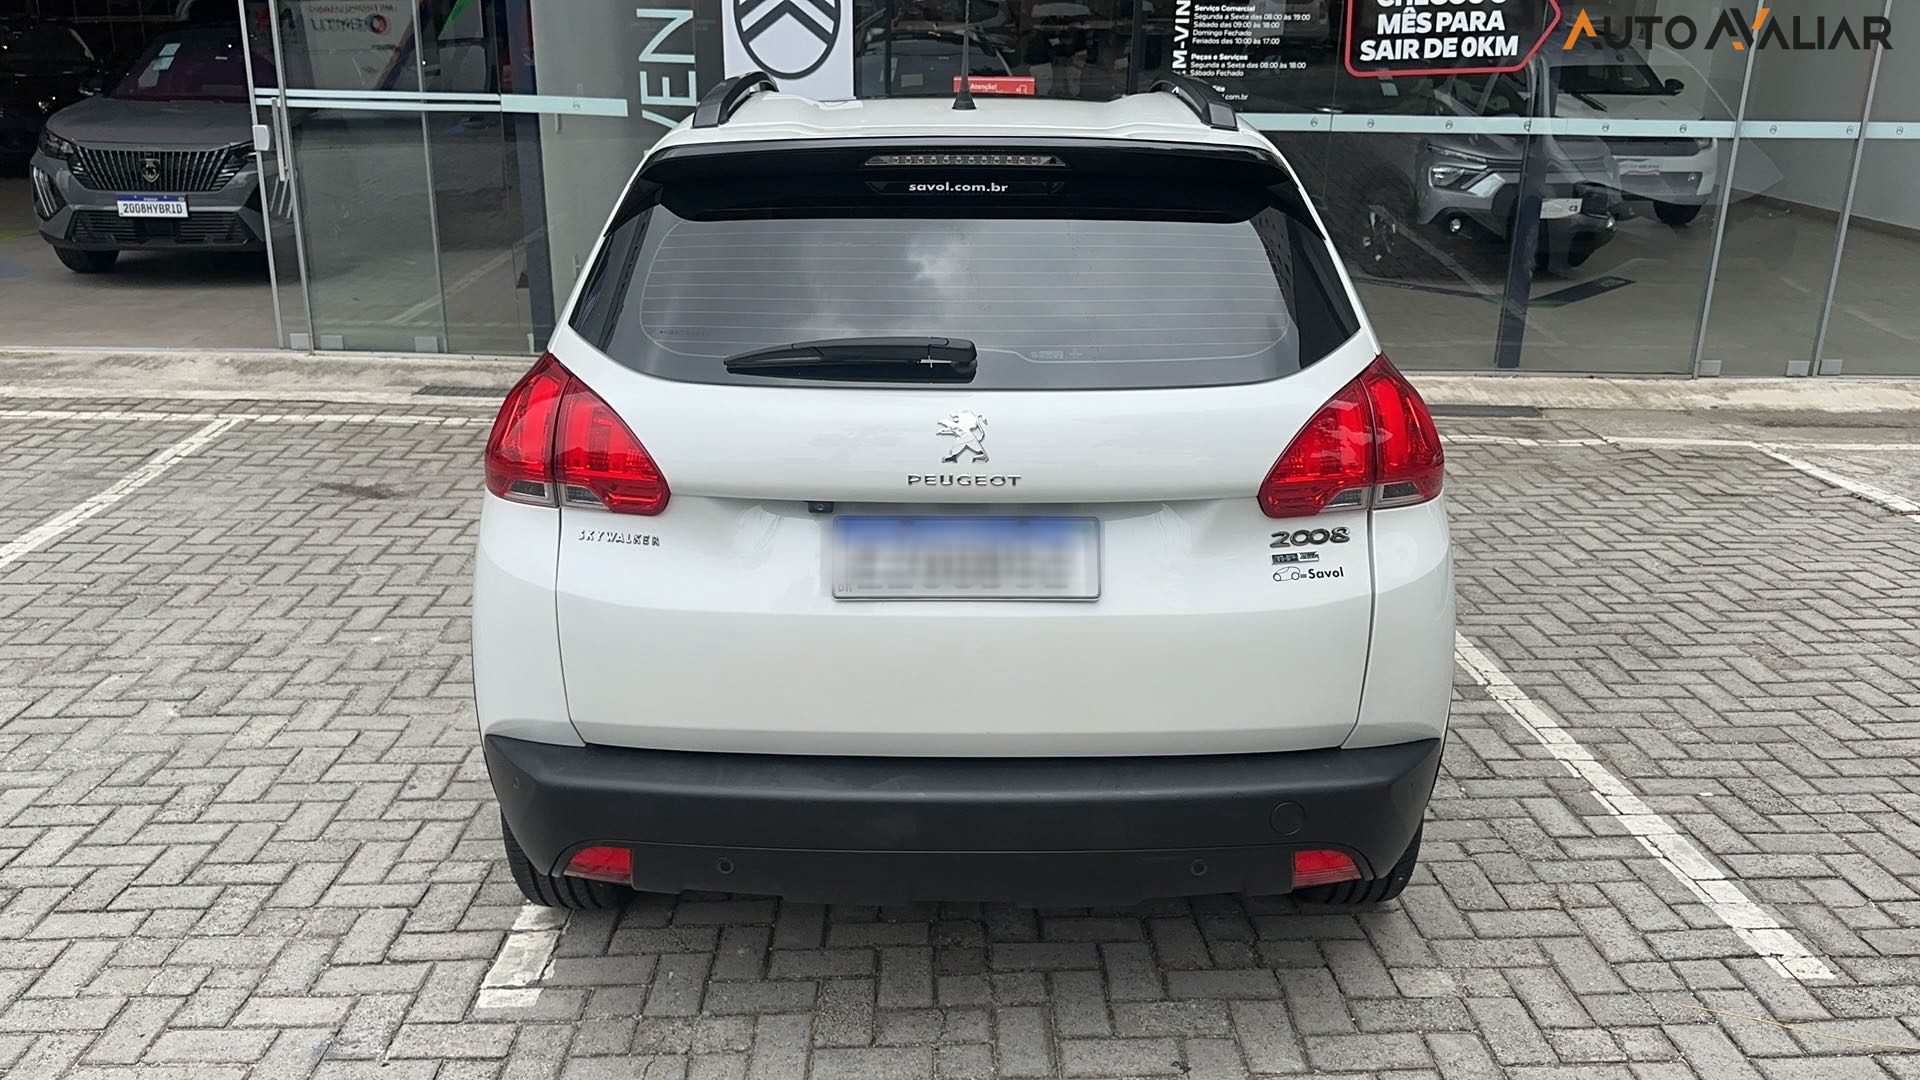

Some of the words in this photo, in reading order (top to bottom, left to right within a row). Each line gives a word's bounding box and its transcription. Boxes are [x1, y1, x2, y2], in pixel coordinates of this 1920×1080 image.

[1376, 7, 1432, 35] MÊS
[1435, 10, 1506, 33] PARA
[1360, 38, 1420, 62] SAIR
[1423, 37, 1457, 59] DE
[1460, 35, 1519, 58] 0KM
[1190, 62, 1220, 70] Segunda
[909, 181, 1009, 192] savol.com.br
[123, 203, 183, 214] 2008HYBRID
[907, 473, 1022, 487] PEUGEOT
[578, 530, 660, 546] SKYWALKER
[1269, 527, 1350, 548] 2008
[1308, 567, 1344, 579] Savol
